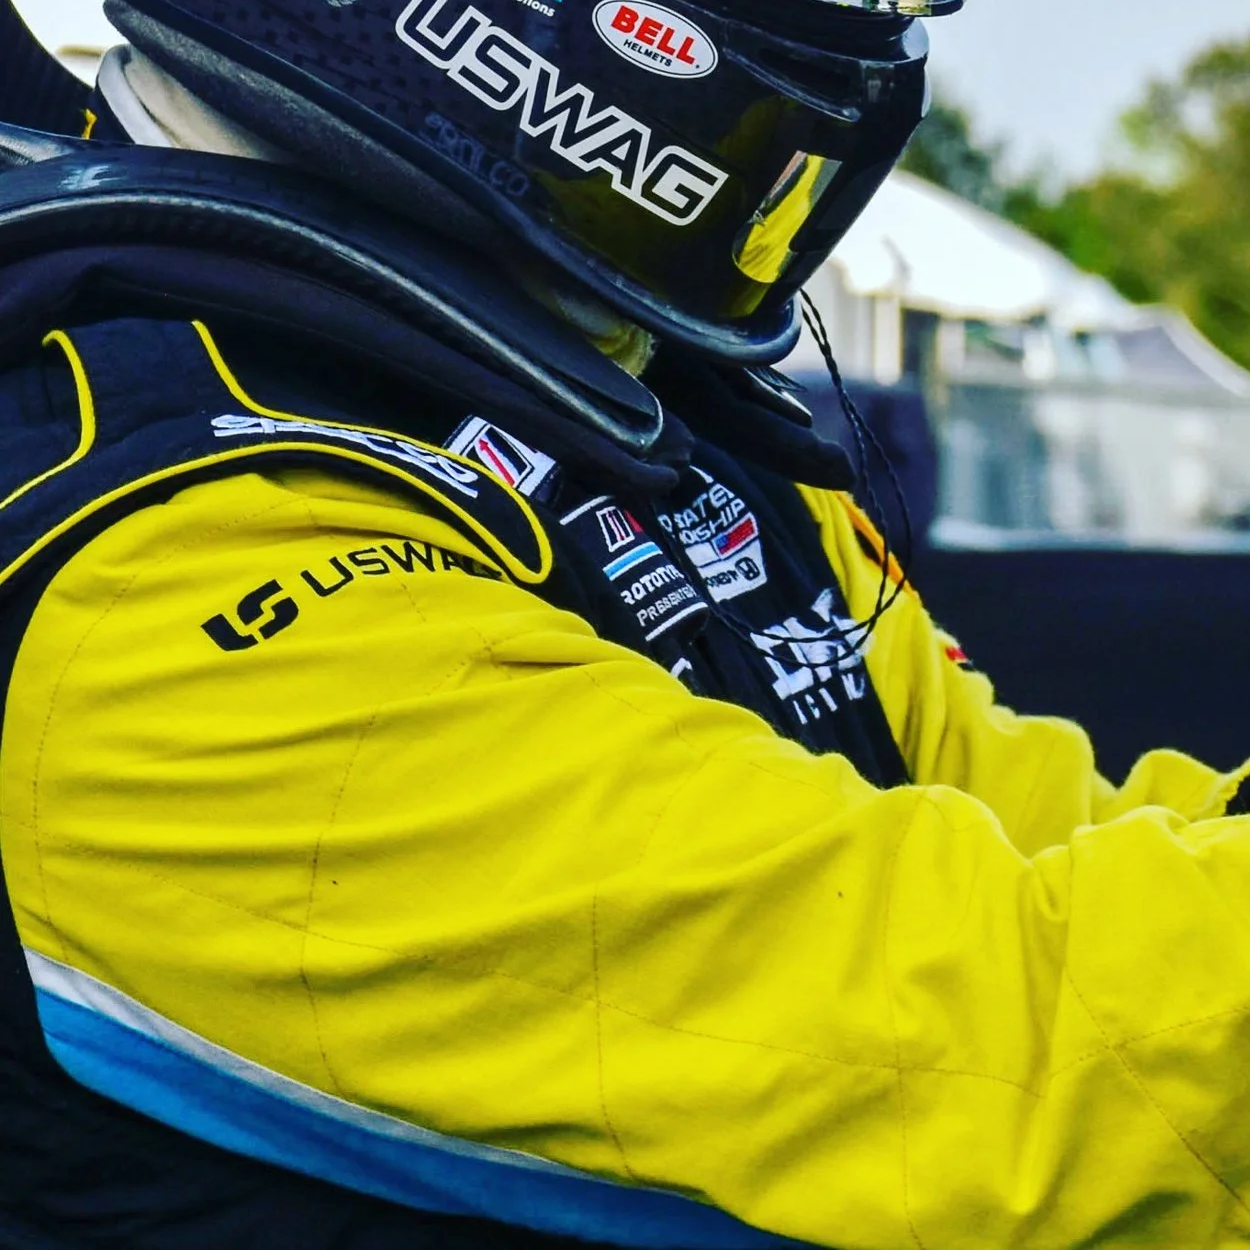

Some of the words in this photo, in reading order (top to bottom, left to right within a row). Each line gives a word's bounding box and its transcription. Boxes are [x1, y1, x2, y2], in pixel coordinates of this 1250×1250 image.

[611, 5, 696, 65] BELL
[624, 39, 673, 67] HELMETS
[300, 541, 502, 597] USWA
